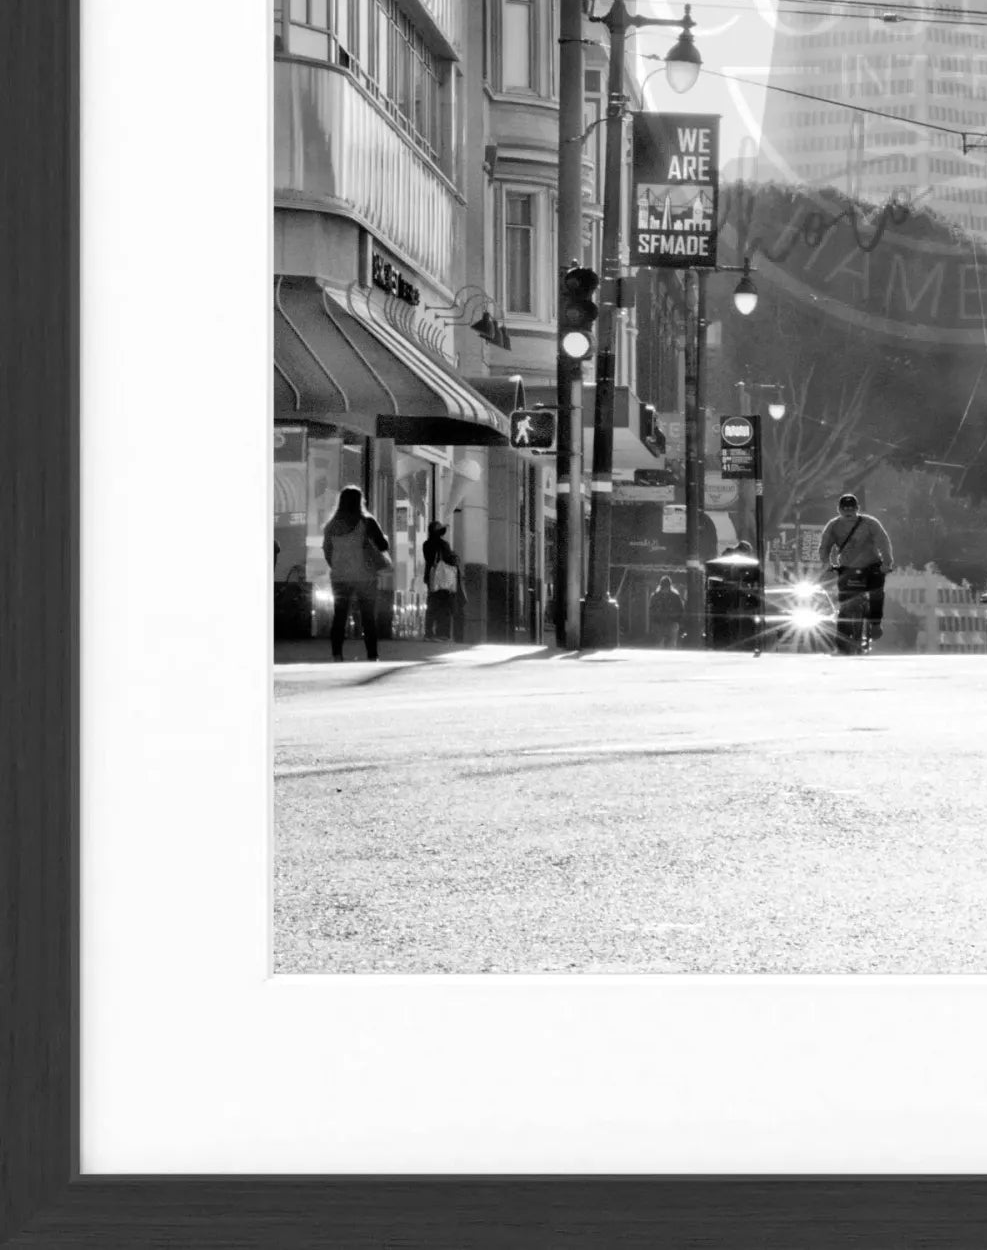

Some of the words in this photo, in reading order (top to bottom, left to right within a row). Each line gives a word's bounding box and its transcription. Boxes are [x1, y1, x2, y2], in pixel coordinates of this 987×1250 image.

[677, 127, 711, 154] WE
[667, 154, 711, 181] ARE
[637, 233, 710, 257] SFMADE
